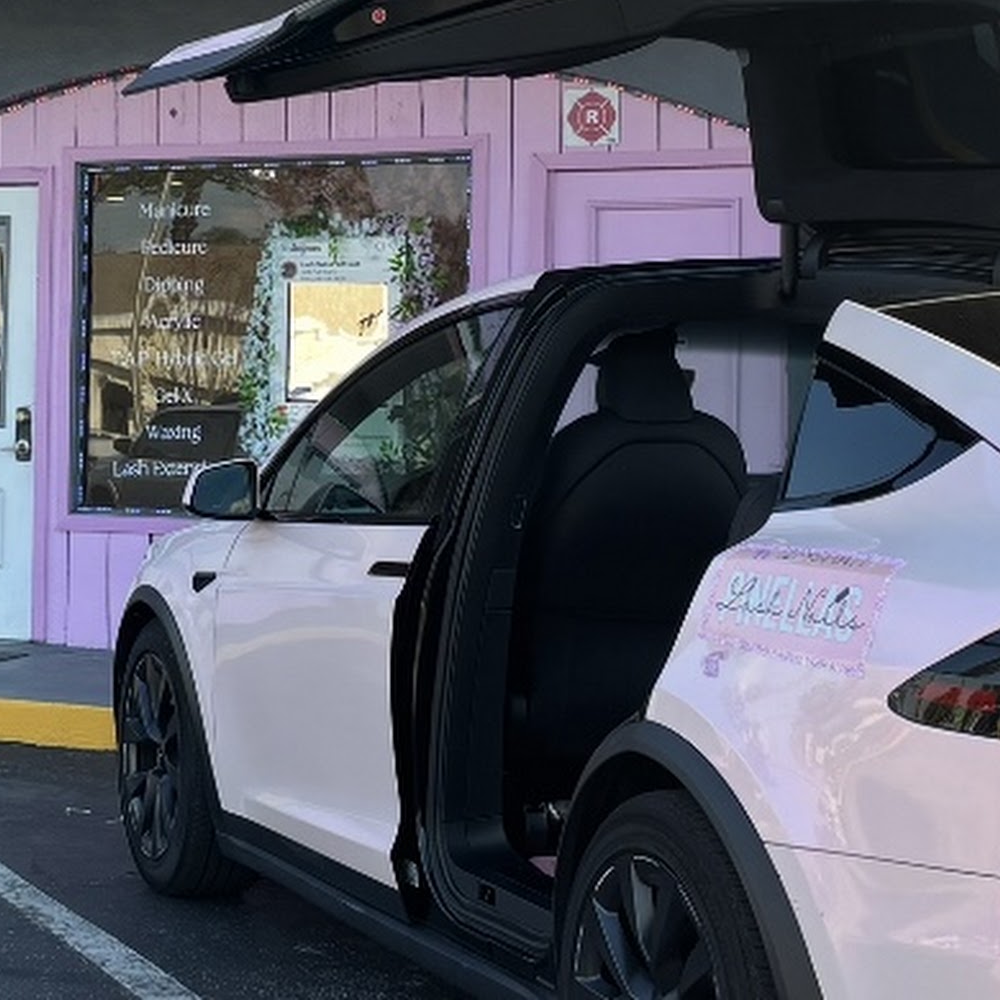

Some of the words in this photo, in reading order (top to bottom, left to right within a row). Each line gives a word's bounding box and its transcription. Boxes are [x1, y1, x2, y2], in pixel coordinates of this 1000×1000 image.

[586, 109, 599, 124] R
[139, 201, 212, 219] Manicure
[145, 424, 202, 445] Waxing
